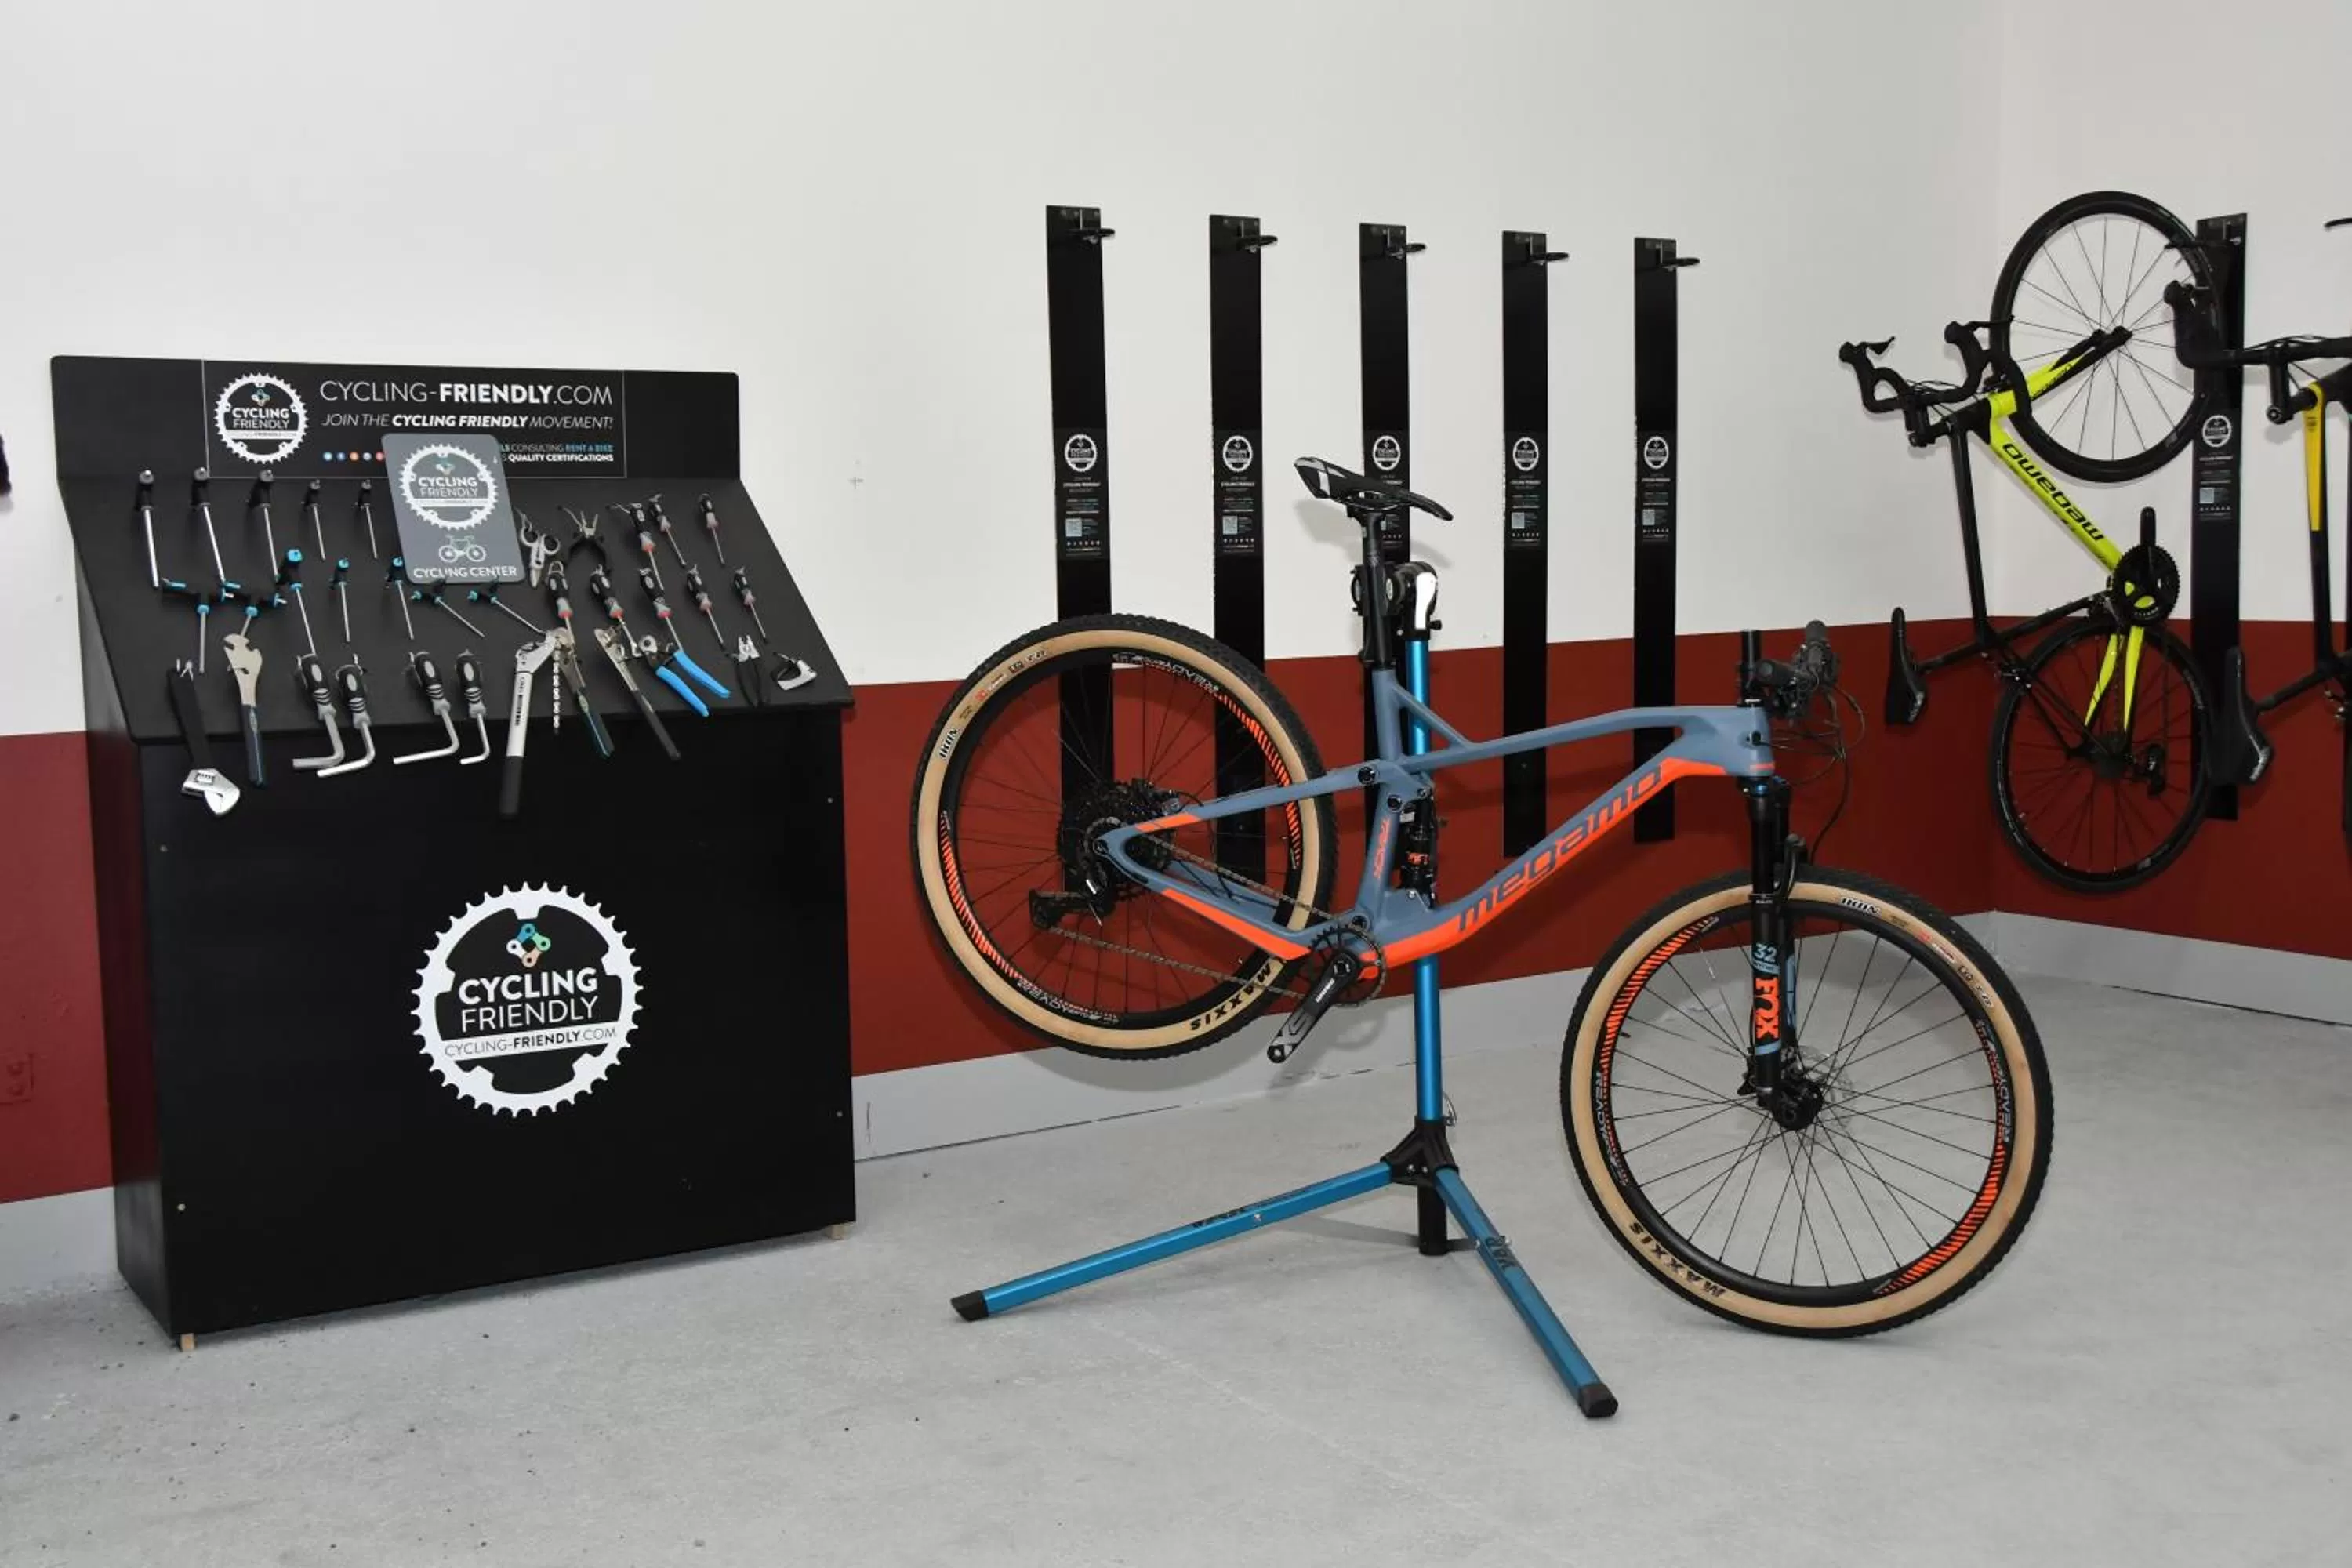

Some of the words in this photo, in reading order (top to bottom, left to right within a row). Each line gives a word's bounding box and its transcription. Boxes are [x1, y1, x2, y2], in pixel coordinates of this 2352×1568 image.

[320, 379, 612, 405] CYCLING-FRIENDLY.COM
[232, 407, 289, 419] CYCLING
[233, 419, 289, 429] FRIENDLY
[321, 413, 360, 427] JOIN
[362, 413, 390, 427] THE
[392, 414, 456, 427] CYCLING
[459, 415, 528, 428] FRIENDLY
[529, 416, 614, 430] MOVEMENT!
[511, 444, 564, 452] CONSULTING
[565, 444, 586, 452] RENT
[508, 453, 544, 463] QUALITY
[546, 454, 614, 463] CERTIFICATIONS
[418, 476, 478, 488] CYCLING
[420, 487, 479, 497] FRIENDLY
[413, 567, 468, 579] CYCLING
[470, 566, 517, 577] CENTER
[1755, 943, 1777, 963] 32
[458, 967, 598, 1005] CYCLING
[461, 996, 599, 1033] FRIENDLY
[1755, 978, 1780, 1040] FOX
[445, 1027, 618, 1057] CYCLING-FRIENDLY.COM
[1628, 1222, 1726, 1298] MAXXIS
